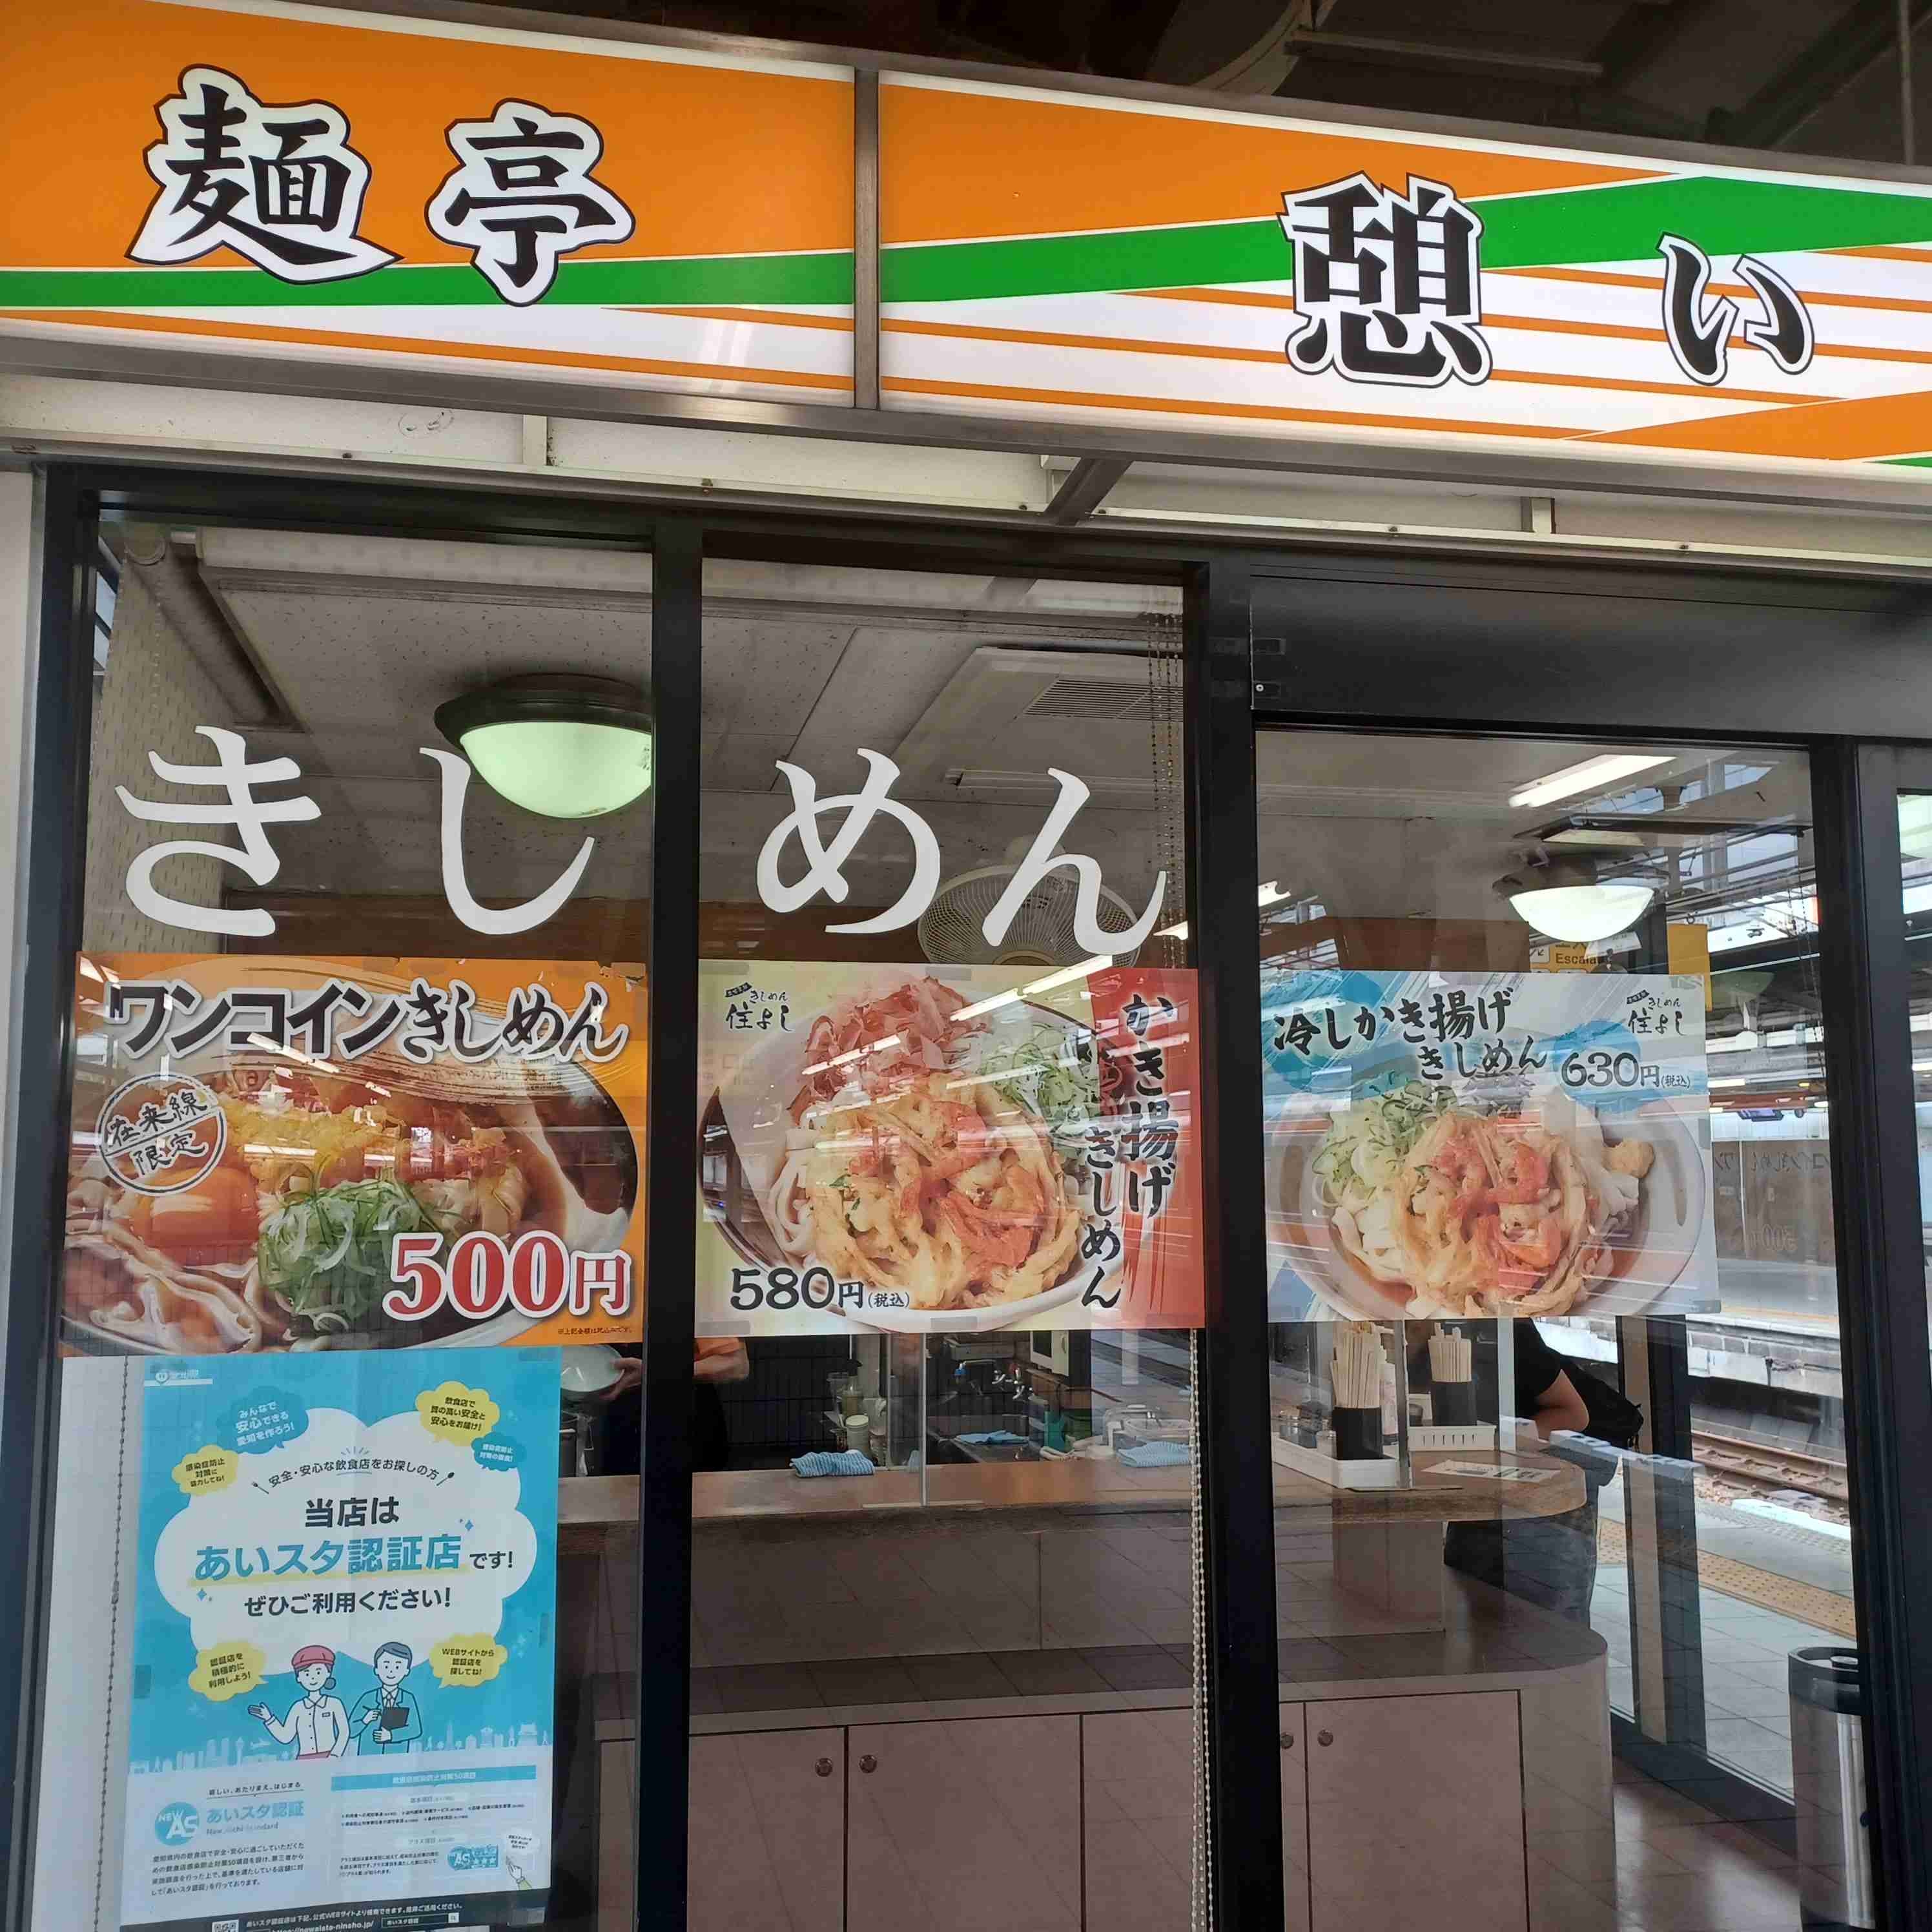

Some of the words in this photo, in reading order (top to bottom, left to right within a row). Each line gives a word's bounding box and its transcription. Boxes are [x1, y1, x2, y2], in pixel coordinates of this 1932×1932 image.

[139, 70, 630, 297] 麺亭
[1280, 174, 1811, 385] 憩い
[115, 725, 1167, 956] きしめん
[105, 978, 628, 1062] ワンコインきしめん
[1273, 987, 1514, 1056] 冷しかき揚げ
[1417, 1035, 1547, 1080] きしめん
[105, 1091, 208, 1147] 在来線
[1120, 992, 1180, 1220] かき揚げ
[133, 1133, 206, 1175] 限定
[1081, 1125, 1122, 1309] きしめん
[382, 1229, 631, 1321] 500円
[235, 1411, 289, 1434] 安心できる
[268, 1457, 440, 1488] 安全・安心な飲食店をお探しの方
[305, 1496, 400, 1528] 当店は
[244, 1588, 451, 1617] ぜひご利用ください!
[206, 1800, 304, 1824] あいスタ認証
